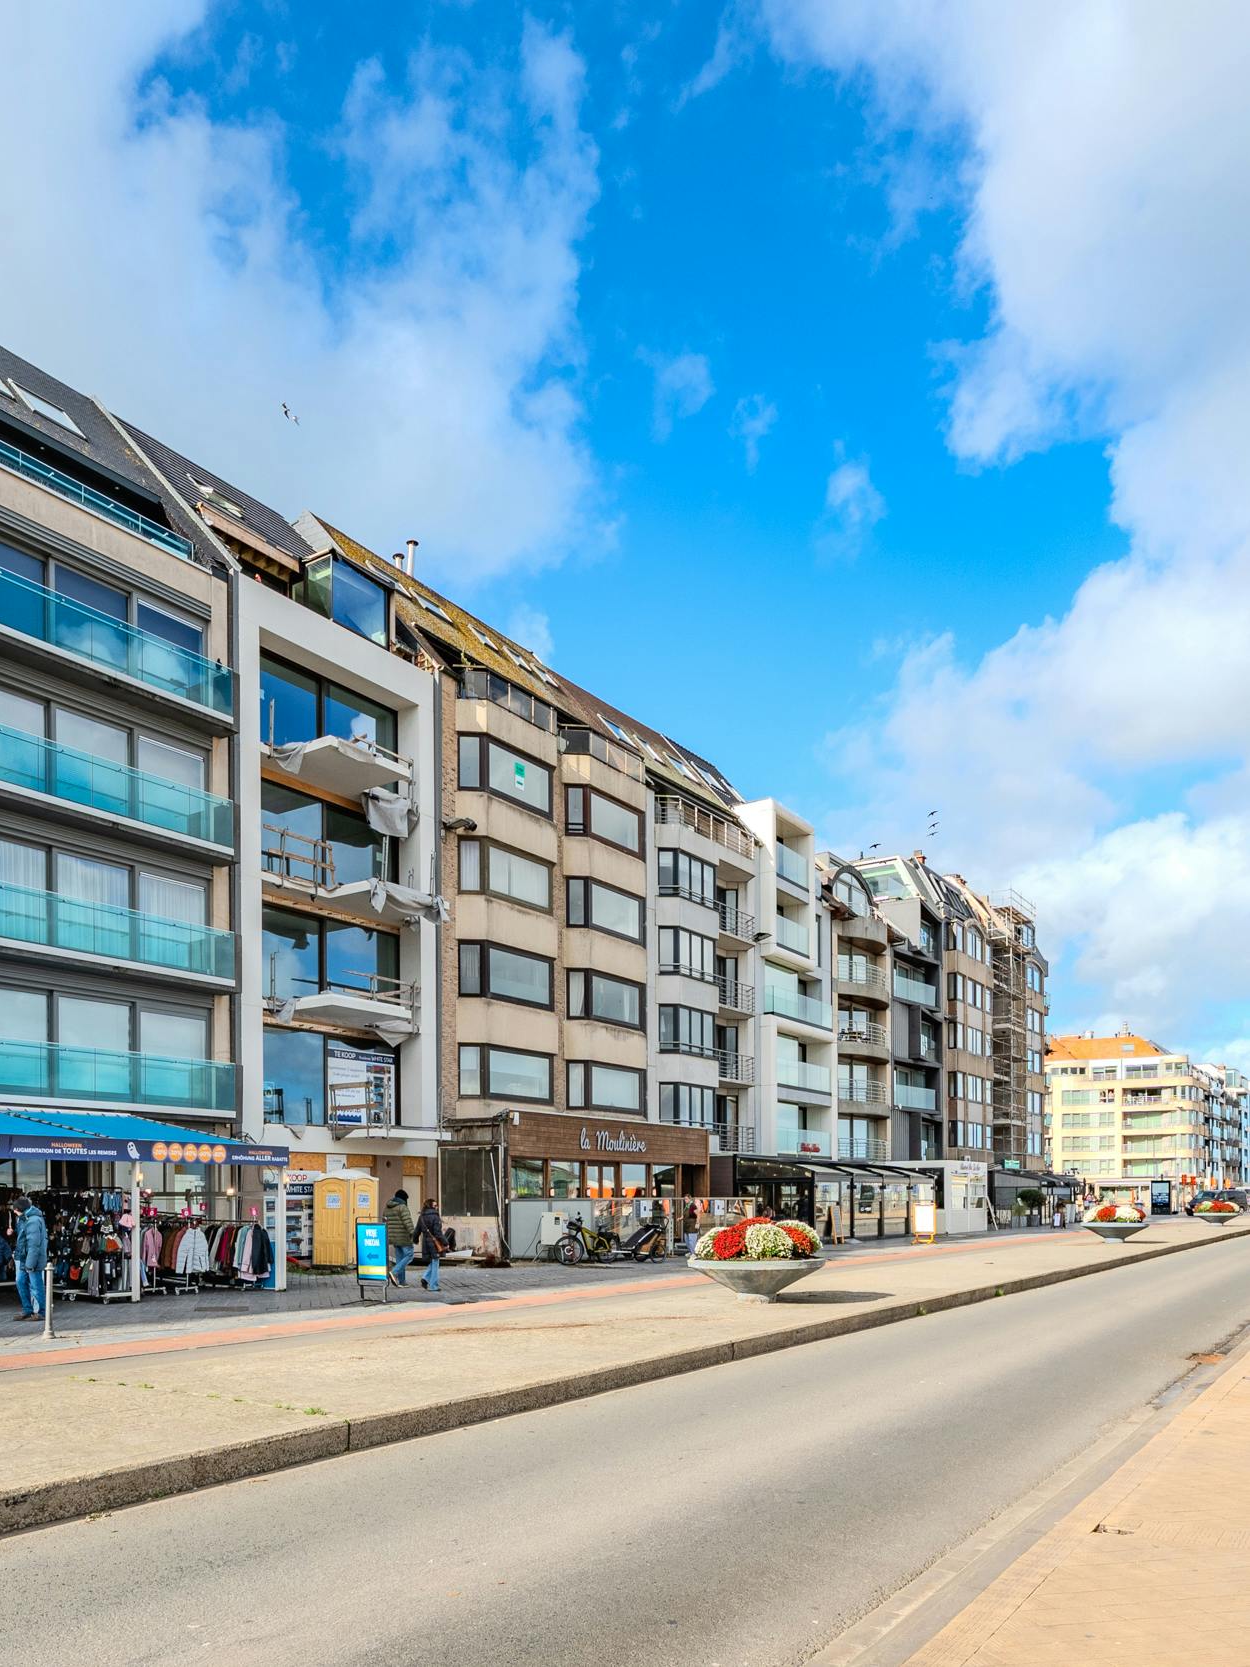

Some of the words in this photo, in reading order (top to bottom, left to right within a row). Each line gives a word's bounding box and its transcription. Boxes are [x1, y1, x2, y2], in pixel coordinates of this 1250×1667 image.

[334, 1050, 341, 1058] TE
[341, 1051, 356, 1059] KOOP
[580, 1127, 591, 1150] la
[596, 1130, 647, 1152] Moulinière
[62, 1147, 88, 1155] TOUTES
[304, 1184, 313, 1193] STA
